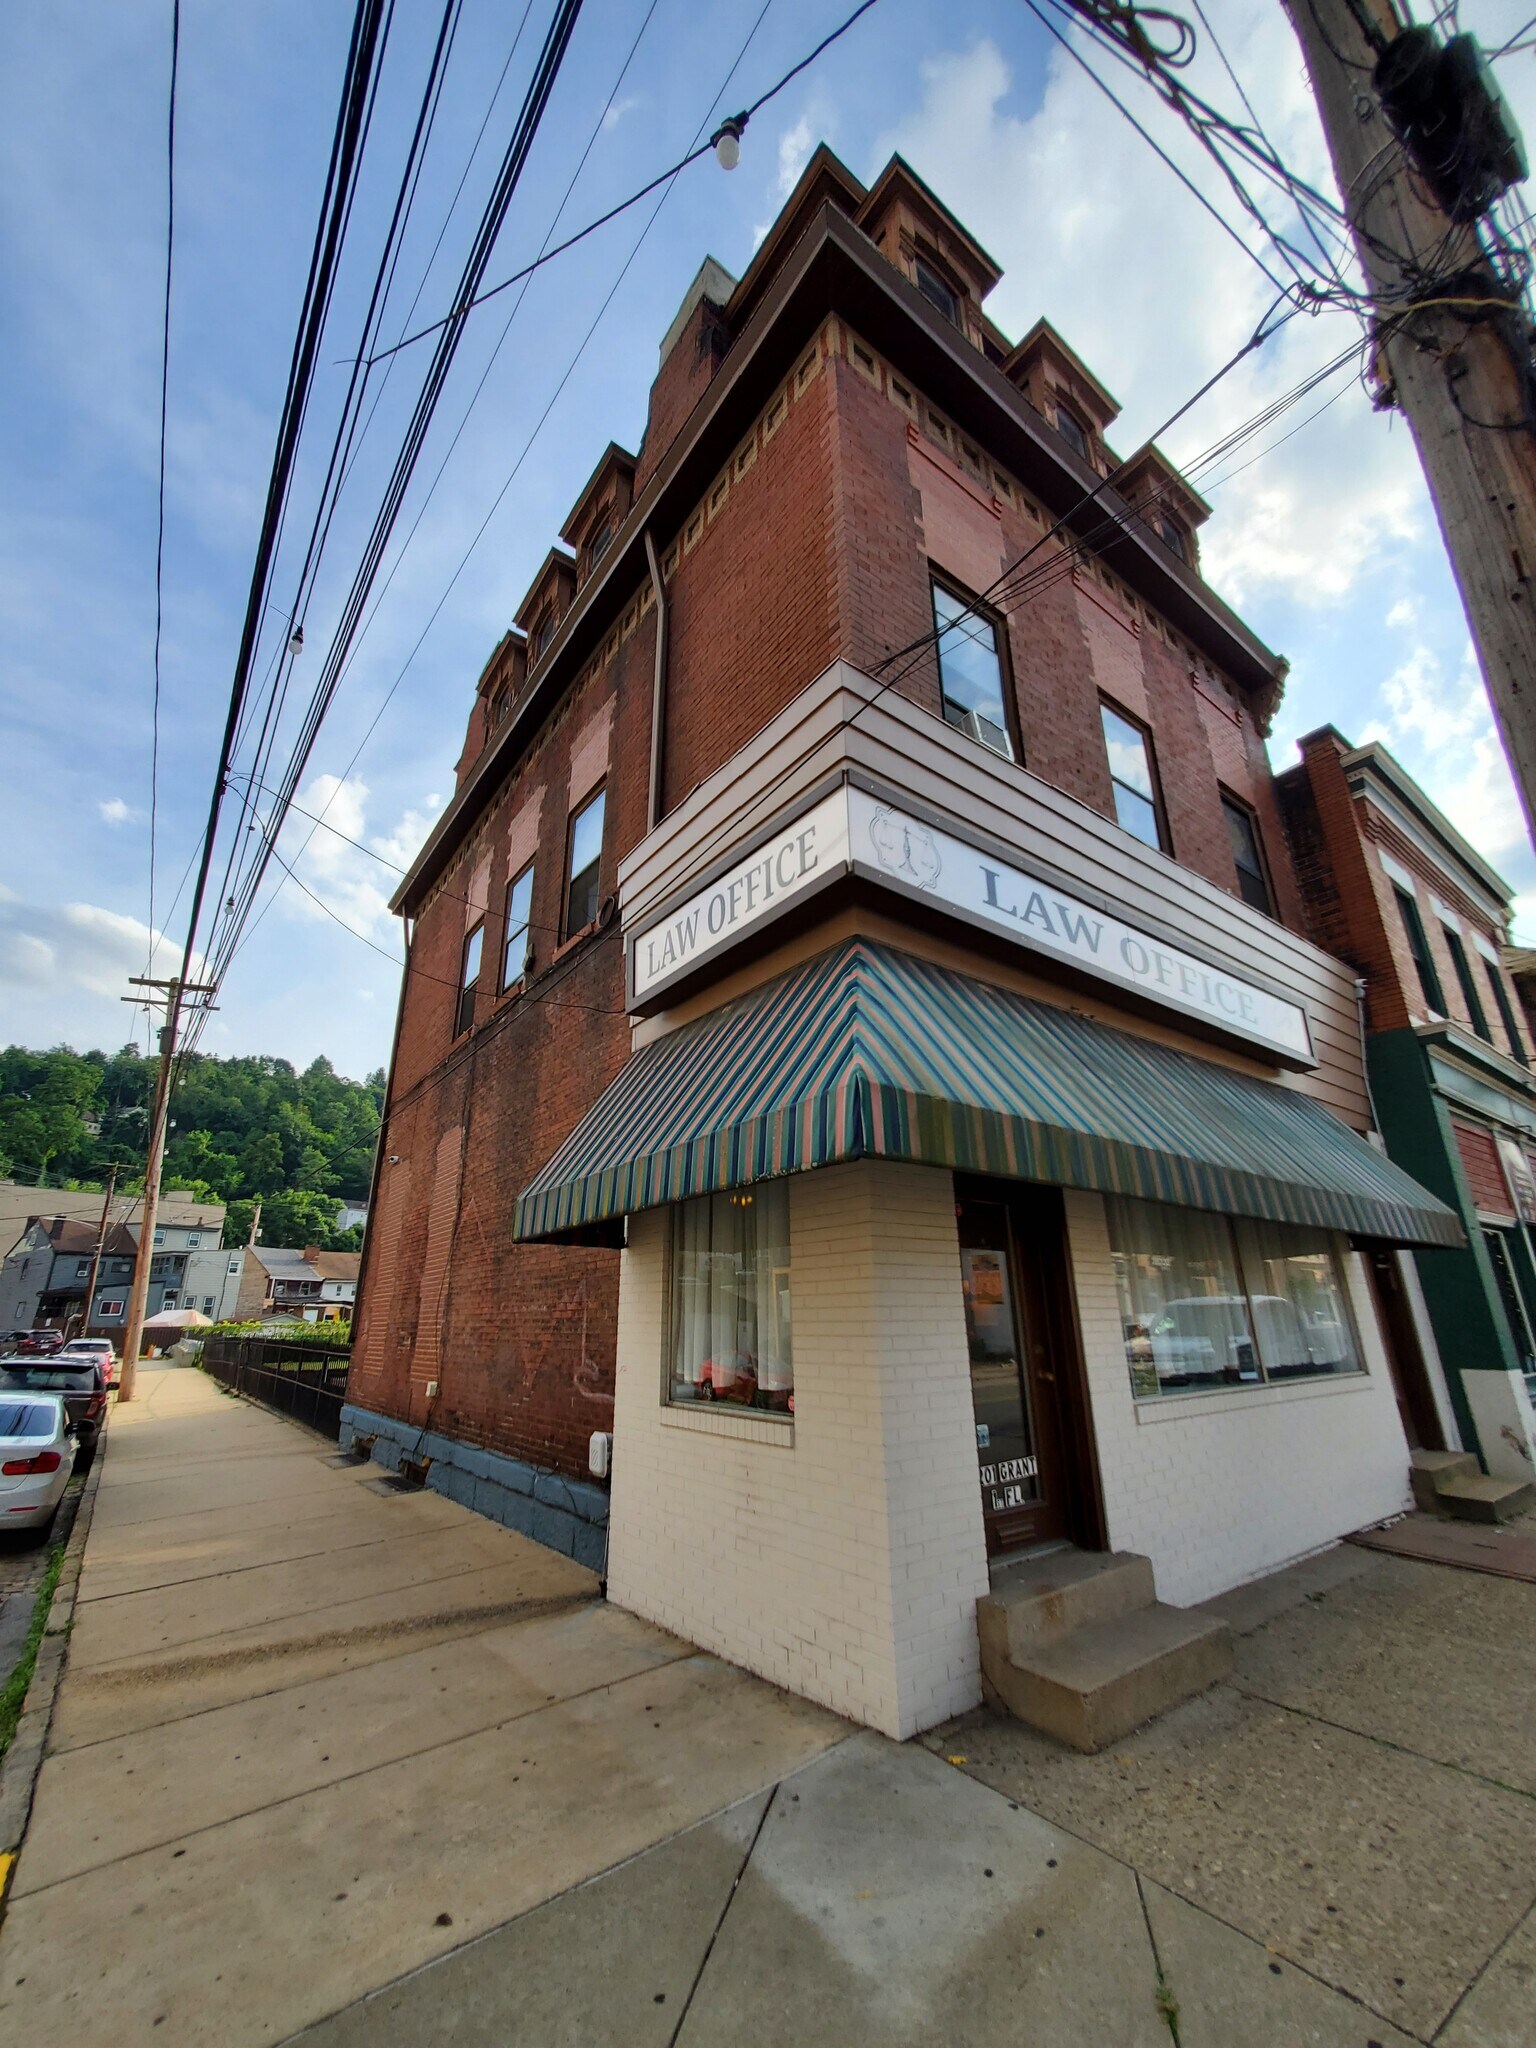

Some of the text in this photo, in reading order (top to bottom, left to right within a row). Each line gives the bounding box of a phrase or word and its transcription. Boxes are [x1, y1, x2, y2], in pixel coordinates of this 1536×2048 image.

[647, 825, 819, 979] LAW OFFICE
[979, 865, 1258, 1025] LAW OFFICE
[999, 1456, 1036, 1481] GRANT
